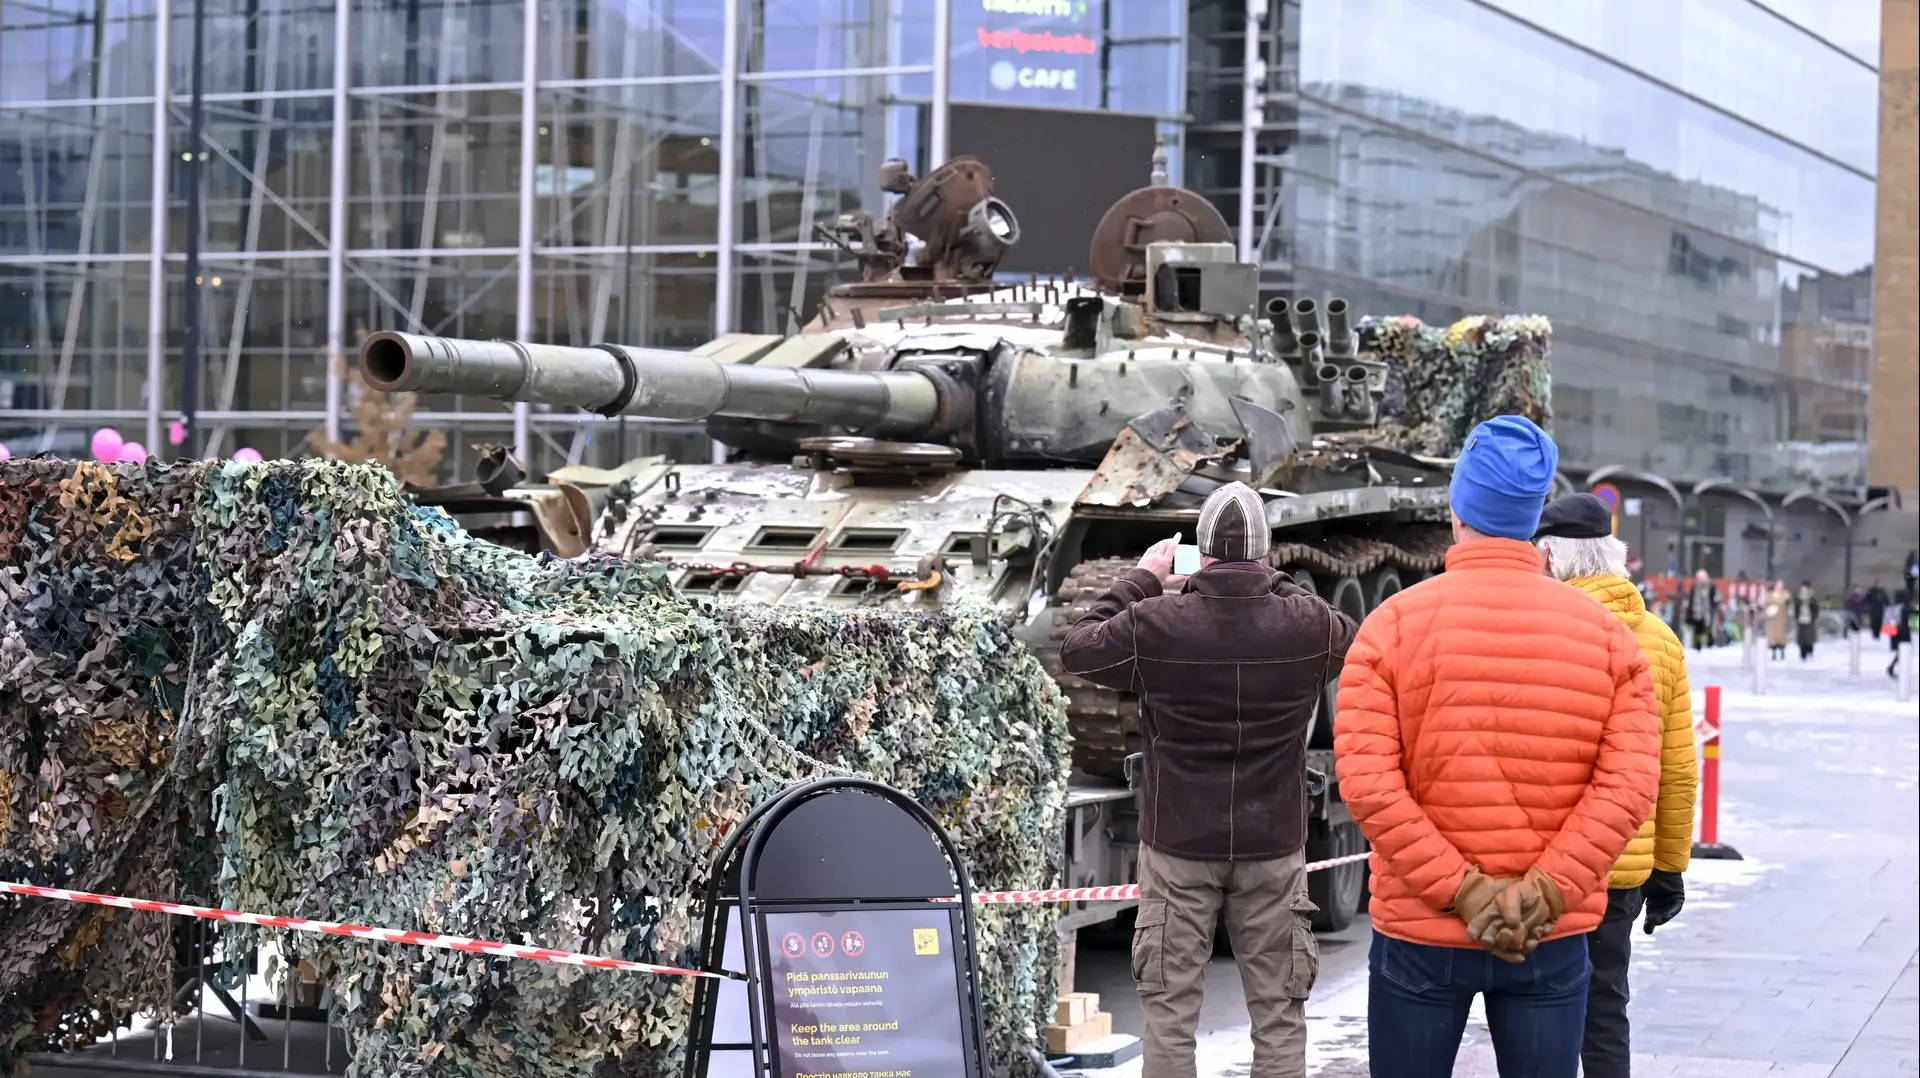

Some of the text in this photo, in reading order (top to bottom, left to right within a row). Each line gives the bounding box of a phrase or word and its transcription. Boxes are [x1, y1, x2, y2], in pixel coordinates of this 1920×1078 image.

[786, 970, 888, 983] Pidä panssarivaunun
[788, 984, 882, 998] ympäristö vapaana
[791, 1024, 817, 1034] Keep
[820, 1022, 836, 1032] the
[863, 1020, 898, 1031] around
[792, 1035, 860, 1046] the tank clear
